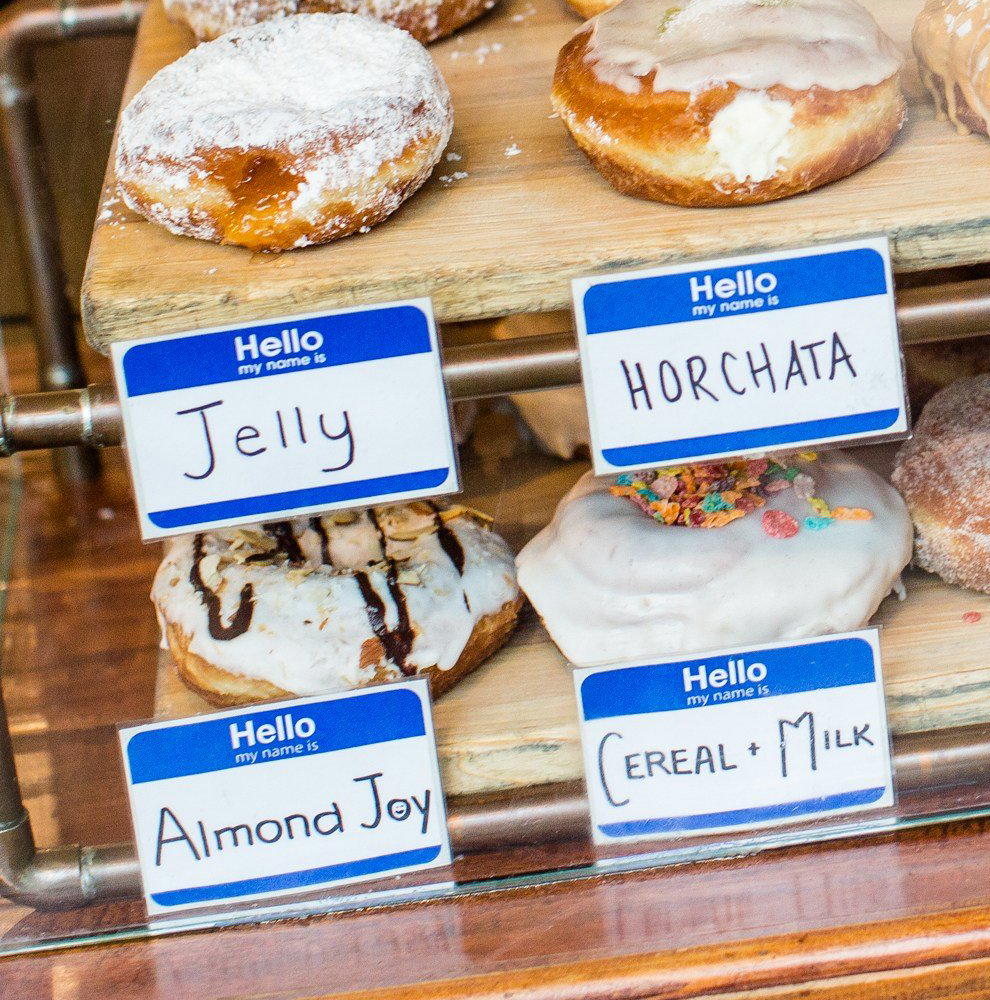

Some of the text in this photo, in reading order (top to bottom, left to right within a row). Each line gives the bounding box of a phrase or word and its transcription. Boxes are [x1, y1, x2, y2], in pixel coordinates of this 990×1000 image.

[688, 268, 778, 302] Hello
[692, 294, 779, 317] my name is
[233, 327, 324, 361] Hello
[237, 351, 327, 377] my name is
[620, 331, 857, 410] HORCHATA
[176, 399, 355, 480] Jelly
[682, 657, 768, 692] Hello
[686, 682, 770, 707] my name is
[229, 713, 316, 749] Hello
[235, 739, 319, 765] my name is
[598, 711, 875, 807] CEREAL + MILK
[155, 772, 431, 867] Almond Joy
